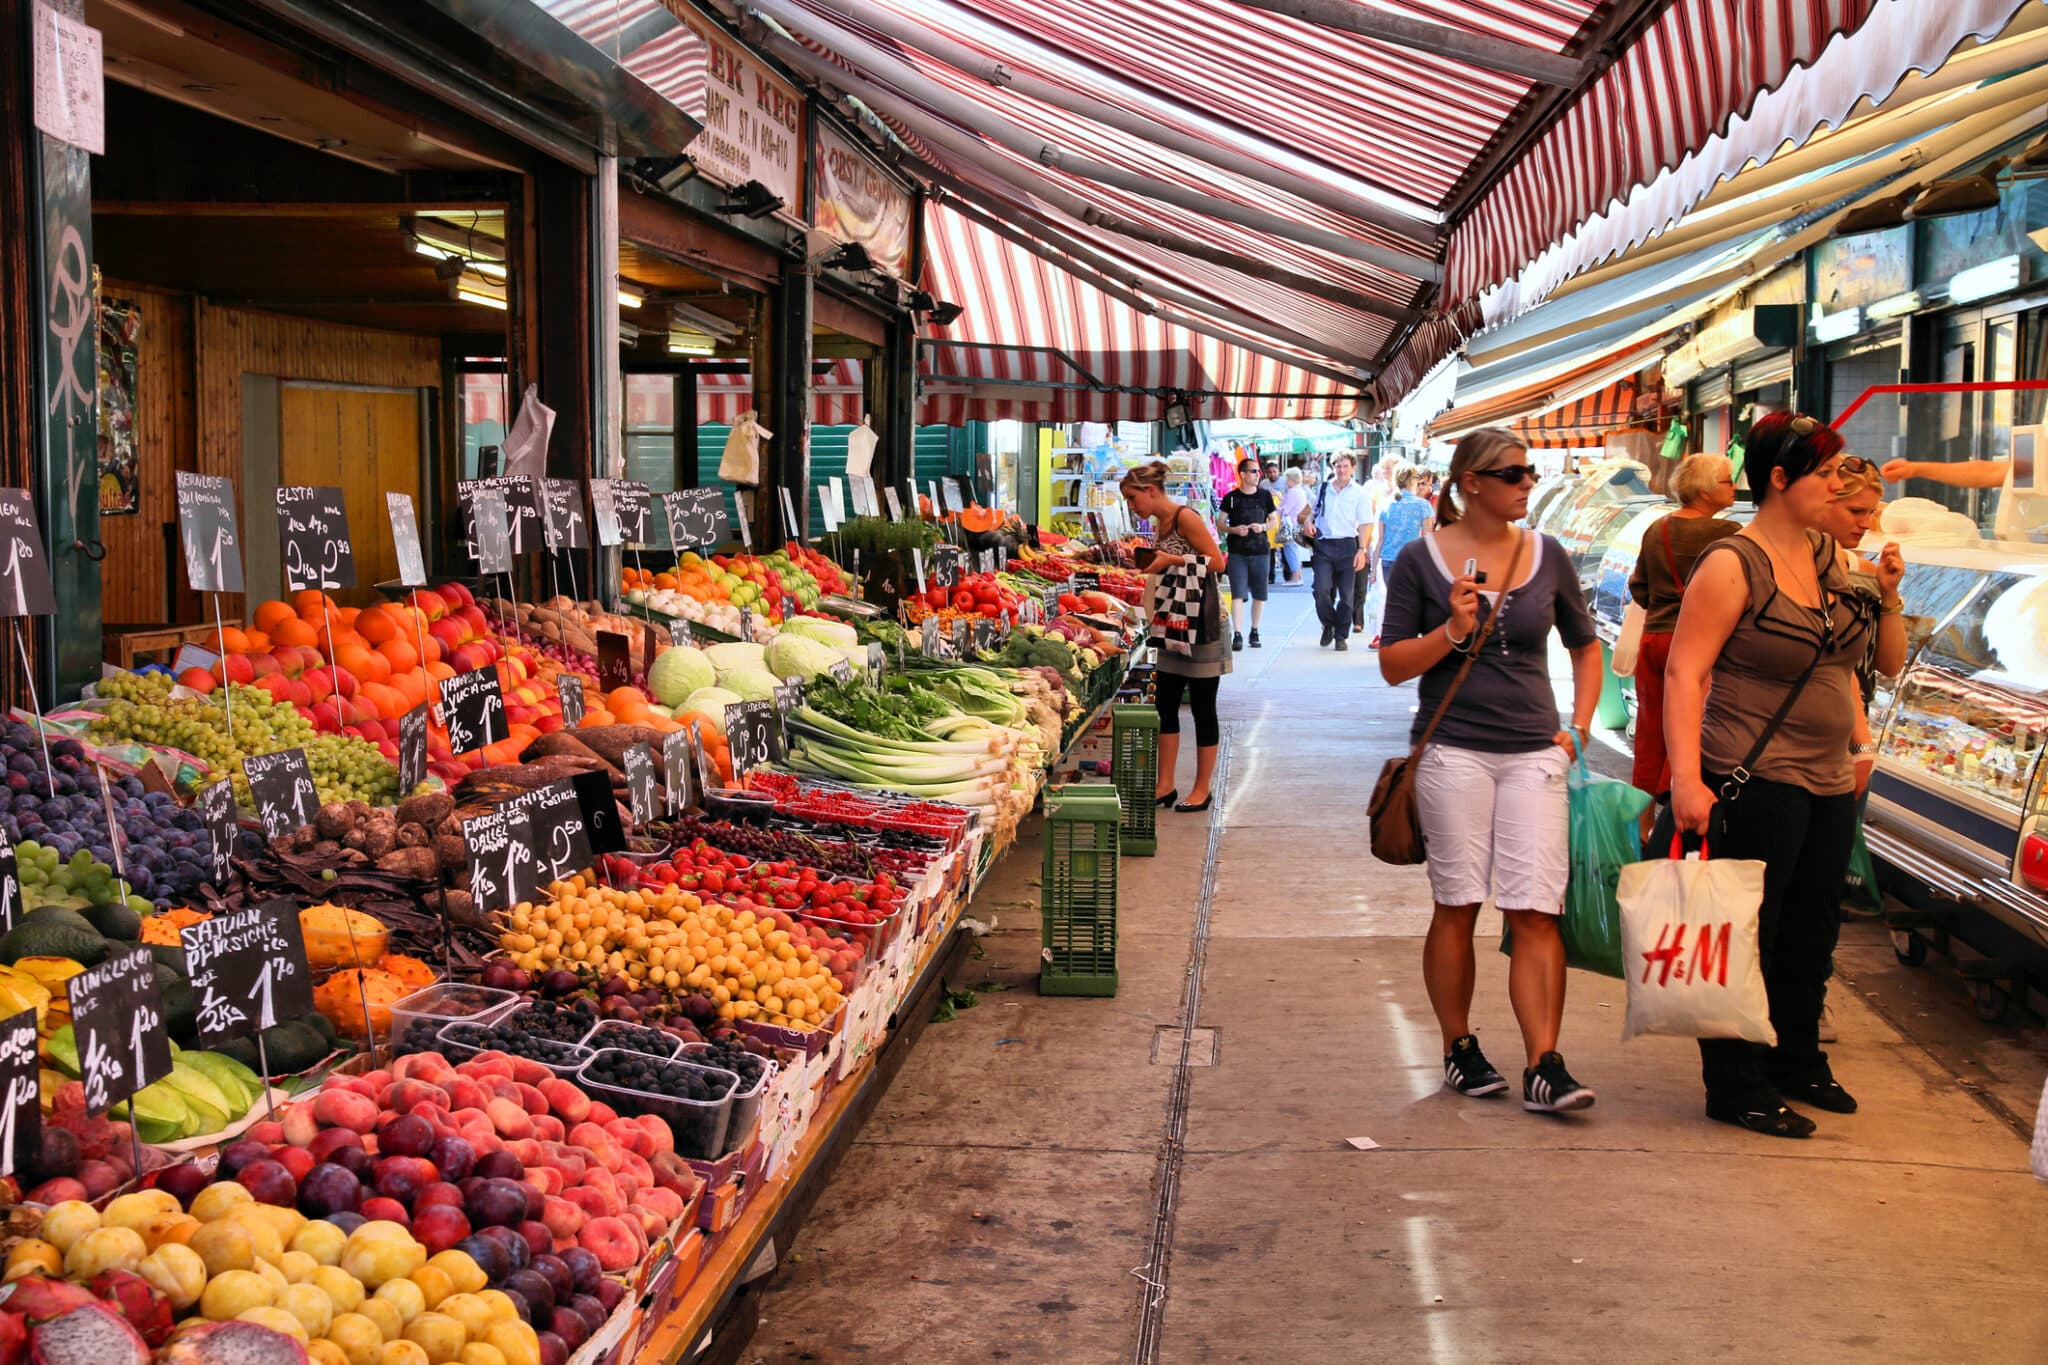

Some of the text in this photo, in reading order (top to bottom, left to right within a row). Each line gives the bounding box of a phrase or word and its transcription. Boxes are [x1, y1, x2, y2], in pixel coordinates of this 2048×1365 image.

[756, 70, 797, 134] KEG
[828, 147, 858, 189] OBST
[276, 487, 314, 504] ELSTA
[662, 487, 712, 501] VALENCIA
[180, 908, 262, 951] SATURN
[186, 917, 280, 978] PFIRSICHE
[1641, 921, 1732, 988] H&M
